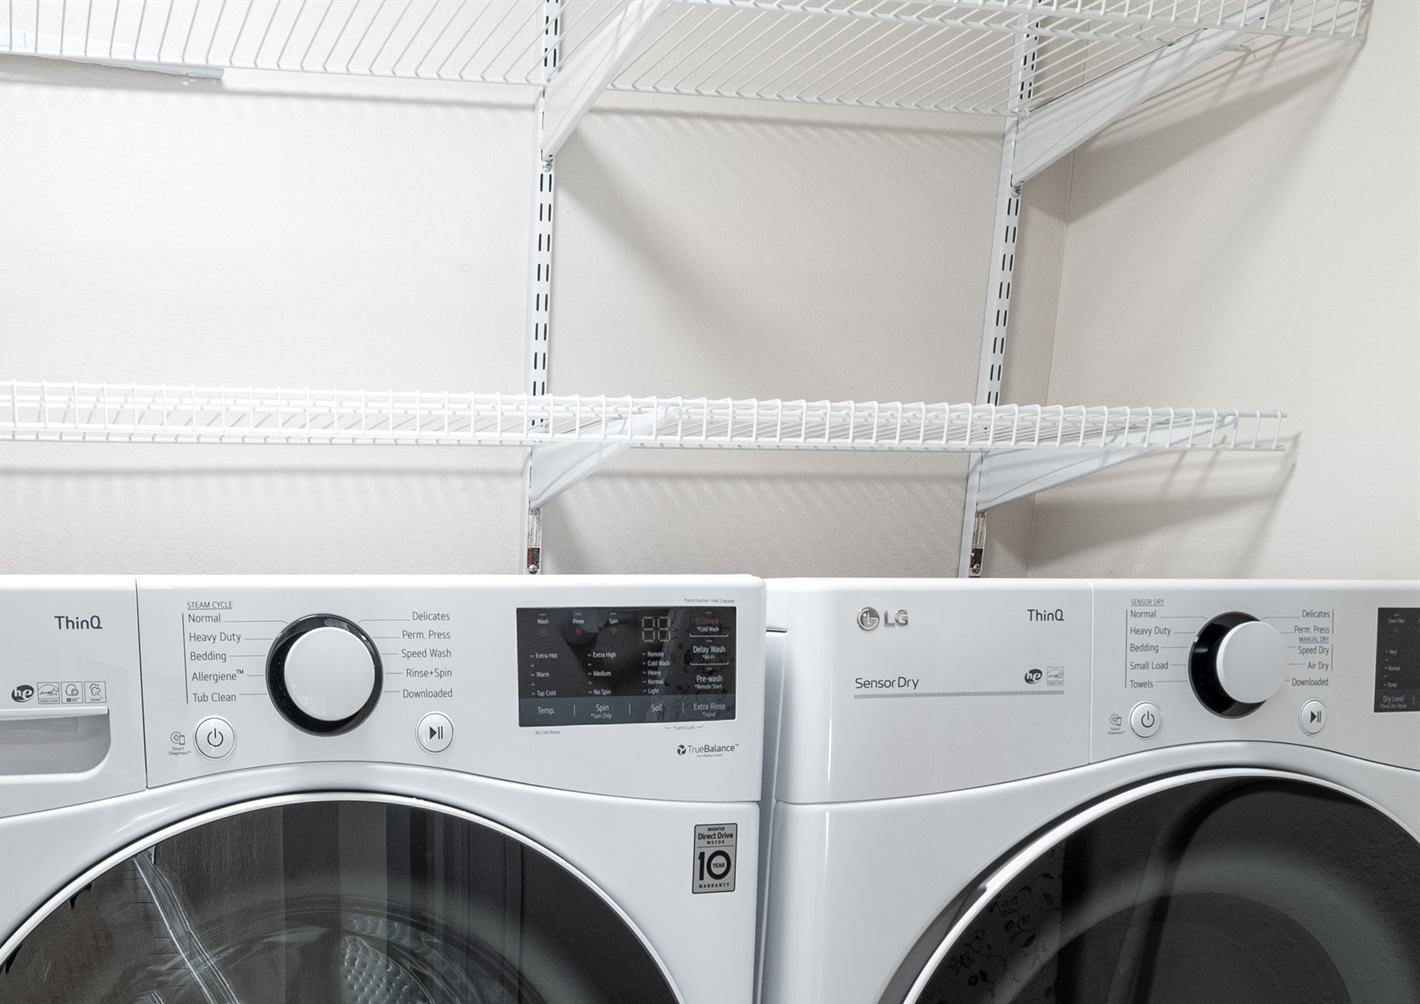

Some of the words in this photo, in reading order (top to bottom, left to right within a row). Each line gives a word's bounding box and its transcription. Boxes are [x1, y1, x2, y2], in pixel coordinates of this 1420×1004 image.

[212, 601, 233, 609] CYCLE
[188, 613, 221, 623] Normal
[412, 611, 450, 621] Delicates
[884, 609, 909, 627] LG
[1027, 608, 1065, 622] ThinQ
[1130, 610, 1157, 618] Normal
[1302, 609, 1330, 618] Delicates
[54, 615, 103, 630] ThinQ
[1130, 627, 1152, 637] Heavy
[1154, 626, 1171, 637] Duty
[1294, 625, 1312, 633] Perm.
[1313, 625, 1330, 633] Press
[189, 632, 217, 644] Heavy
[220, 632, 241, 643] Duty
[402, 630, 426, 639] Perm.
[428, 630, 451, 639] Press
[710, 645, 726, 653] Wash
[1130, 643, 1159, 654] Bedding
[1298, 645, 1317, 656] Speed
[1318, 645, 1329, 656] Dry
[190, 651, 227, 663] Bedding
[401, 649, 427, 660] Speed
[429, 648, 452, 658] Wash
[1130, 661, 1149, 670] Small
[1151, 661, 1169, 670] Load
[1307, 661, 1316, 669] Air
[1318, 661, 1329, 671] Dry
[406, 668, 452, 679] Rinse+Spin
[1130, 680, 1154, 688] Towels
[1291, 678, 1329, 686] Downloaded
[192, 693, 209, 702] Tub
[211, 692, 237, 702] Clean
[402, 688, 453, 699] Downloaded
[537, 706, 555, 715] Temp.
[596, 704, 609, 713] Spin
[651, 704, 662, 712] Soil
[698, 832, 716, 840] Direct
[698, 850, 731, 880] 10
